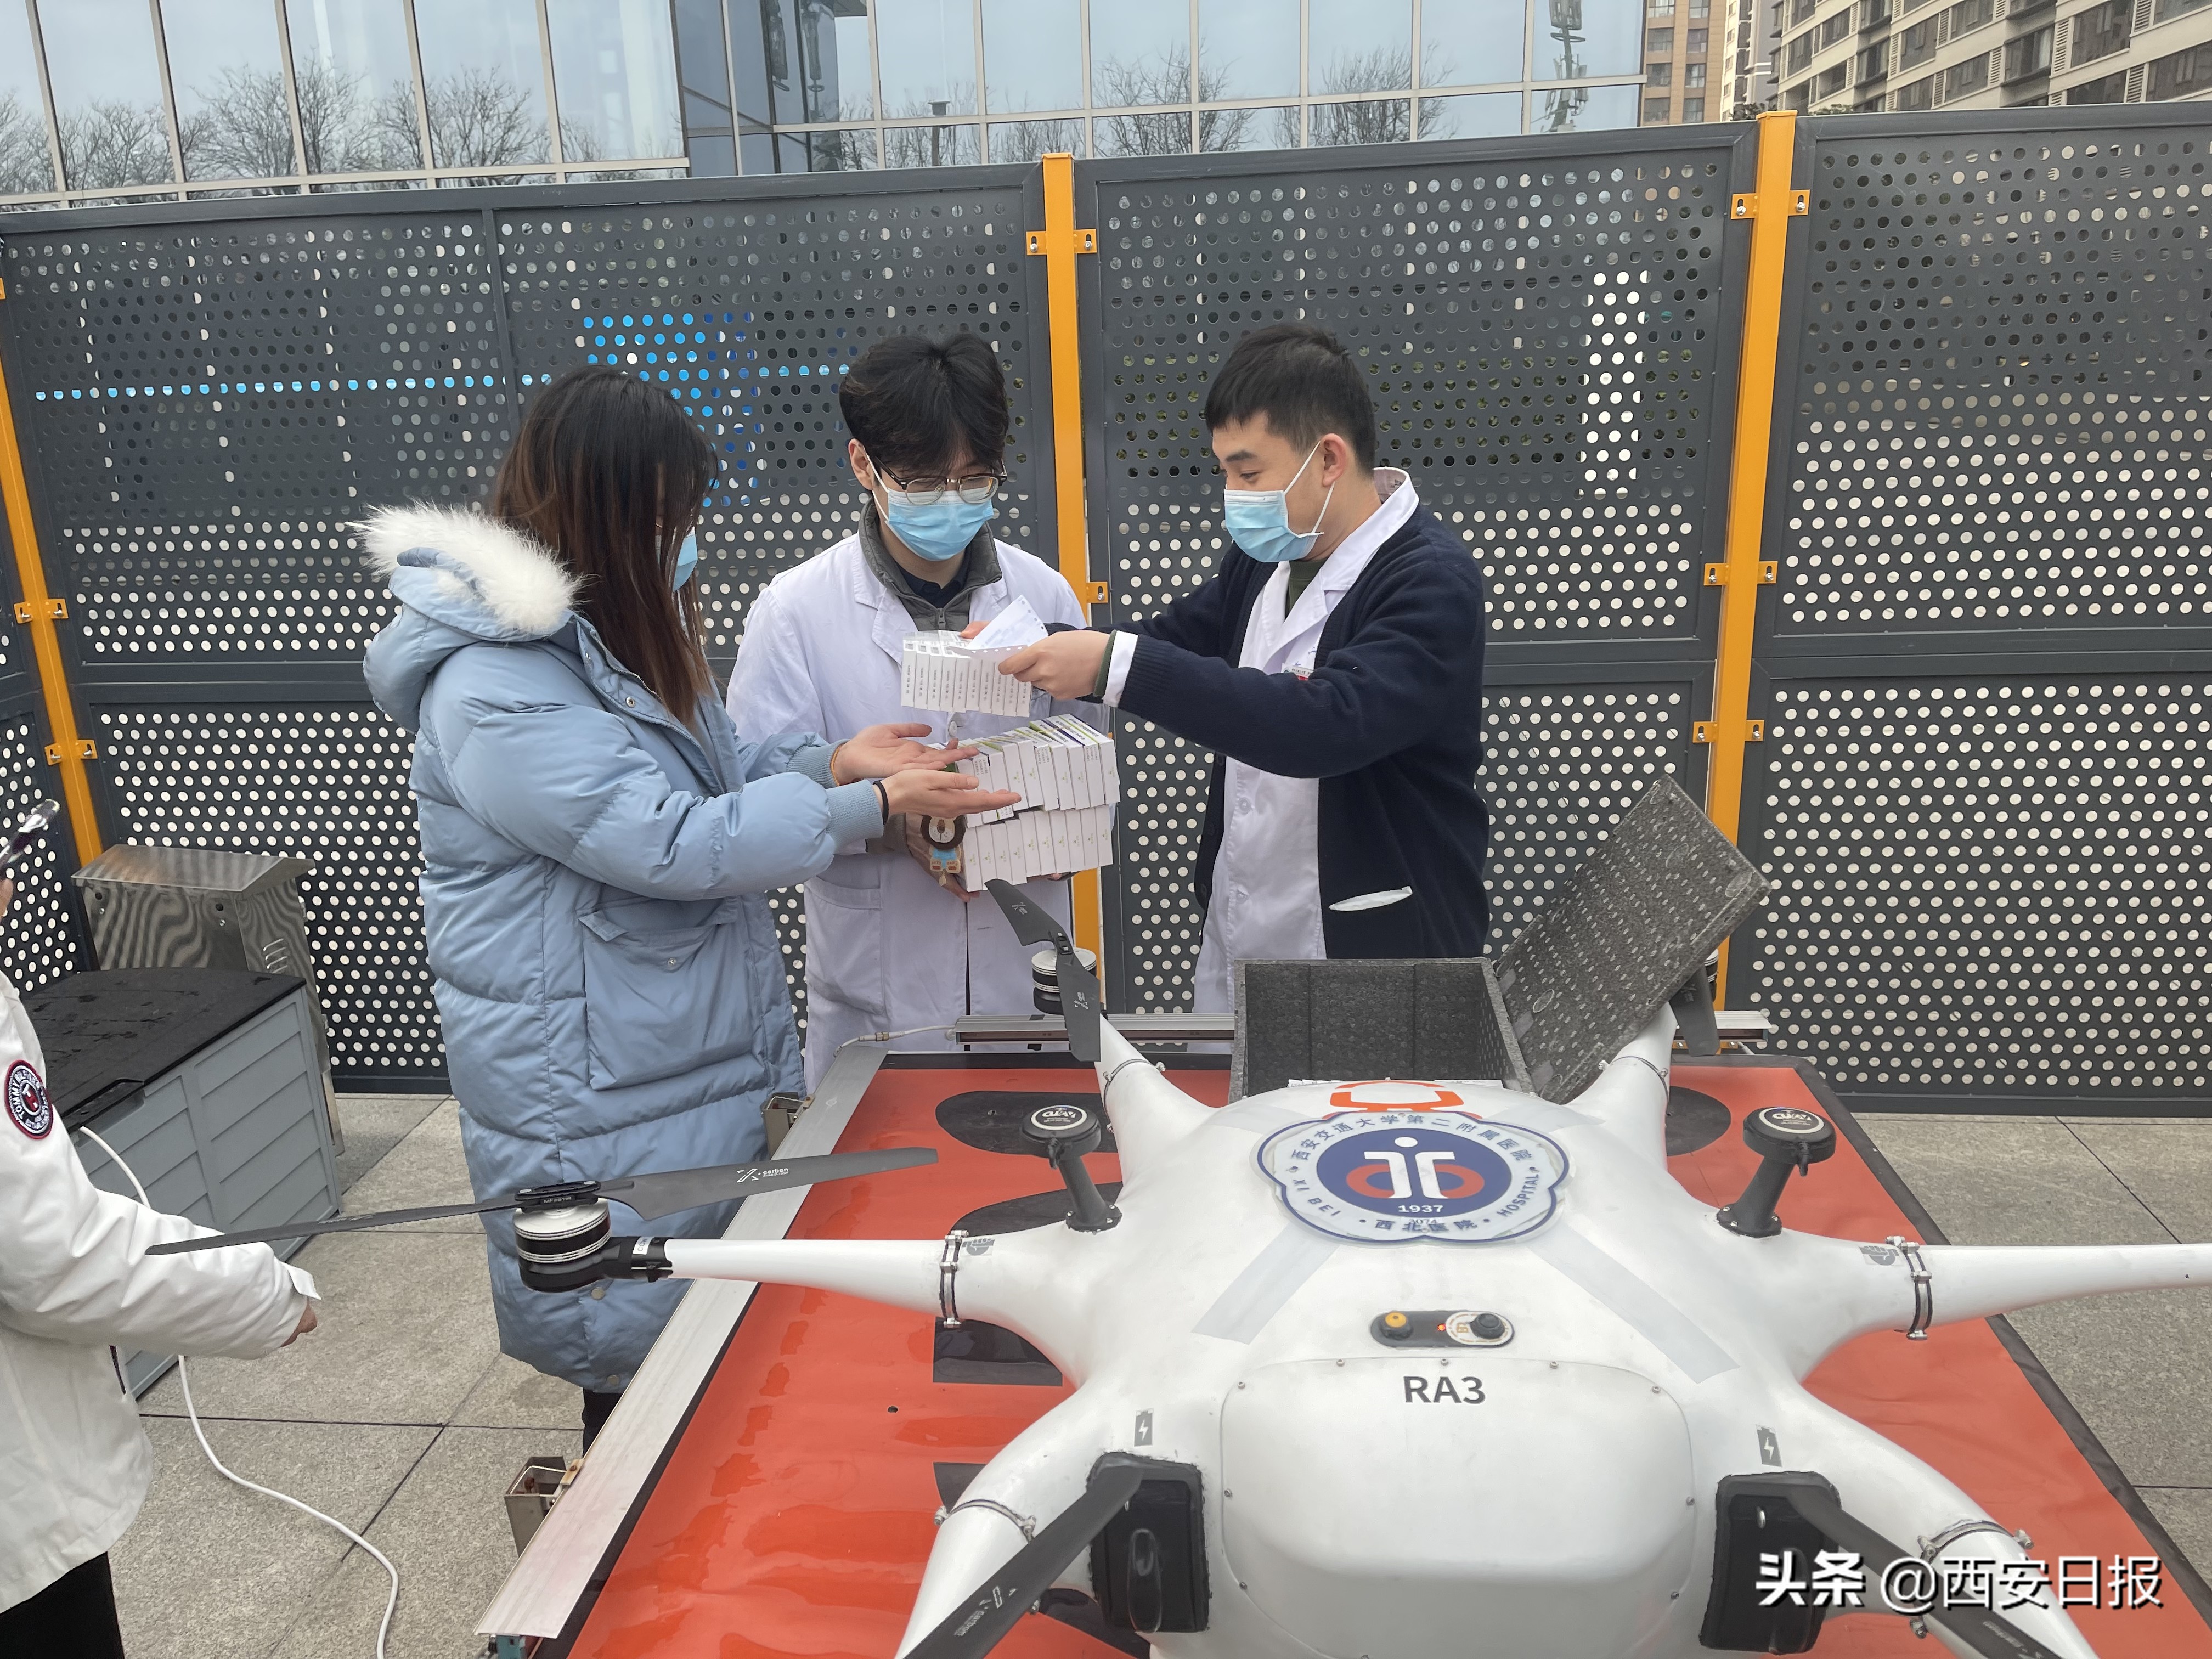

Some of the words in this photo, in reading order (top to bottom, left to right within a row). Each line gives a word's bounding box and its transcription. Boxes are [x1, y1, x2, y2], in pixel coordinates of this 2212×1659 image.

[1291, 1114, 1532, 1161] 西安交通大学第二附属医院
[1307, 1197, 1341, 1216] BEI
[1496, 1173, 1539, 1217] HOSPITAL
[1397, 1204, 1444, 1213] 1937
[1375, 1218, 1478, 1233] 西北医院
[1403, 1376, 1486, 1404] RA3
